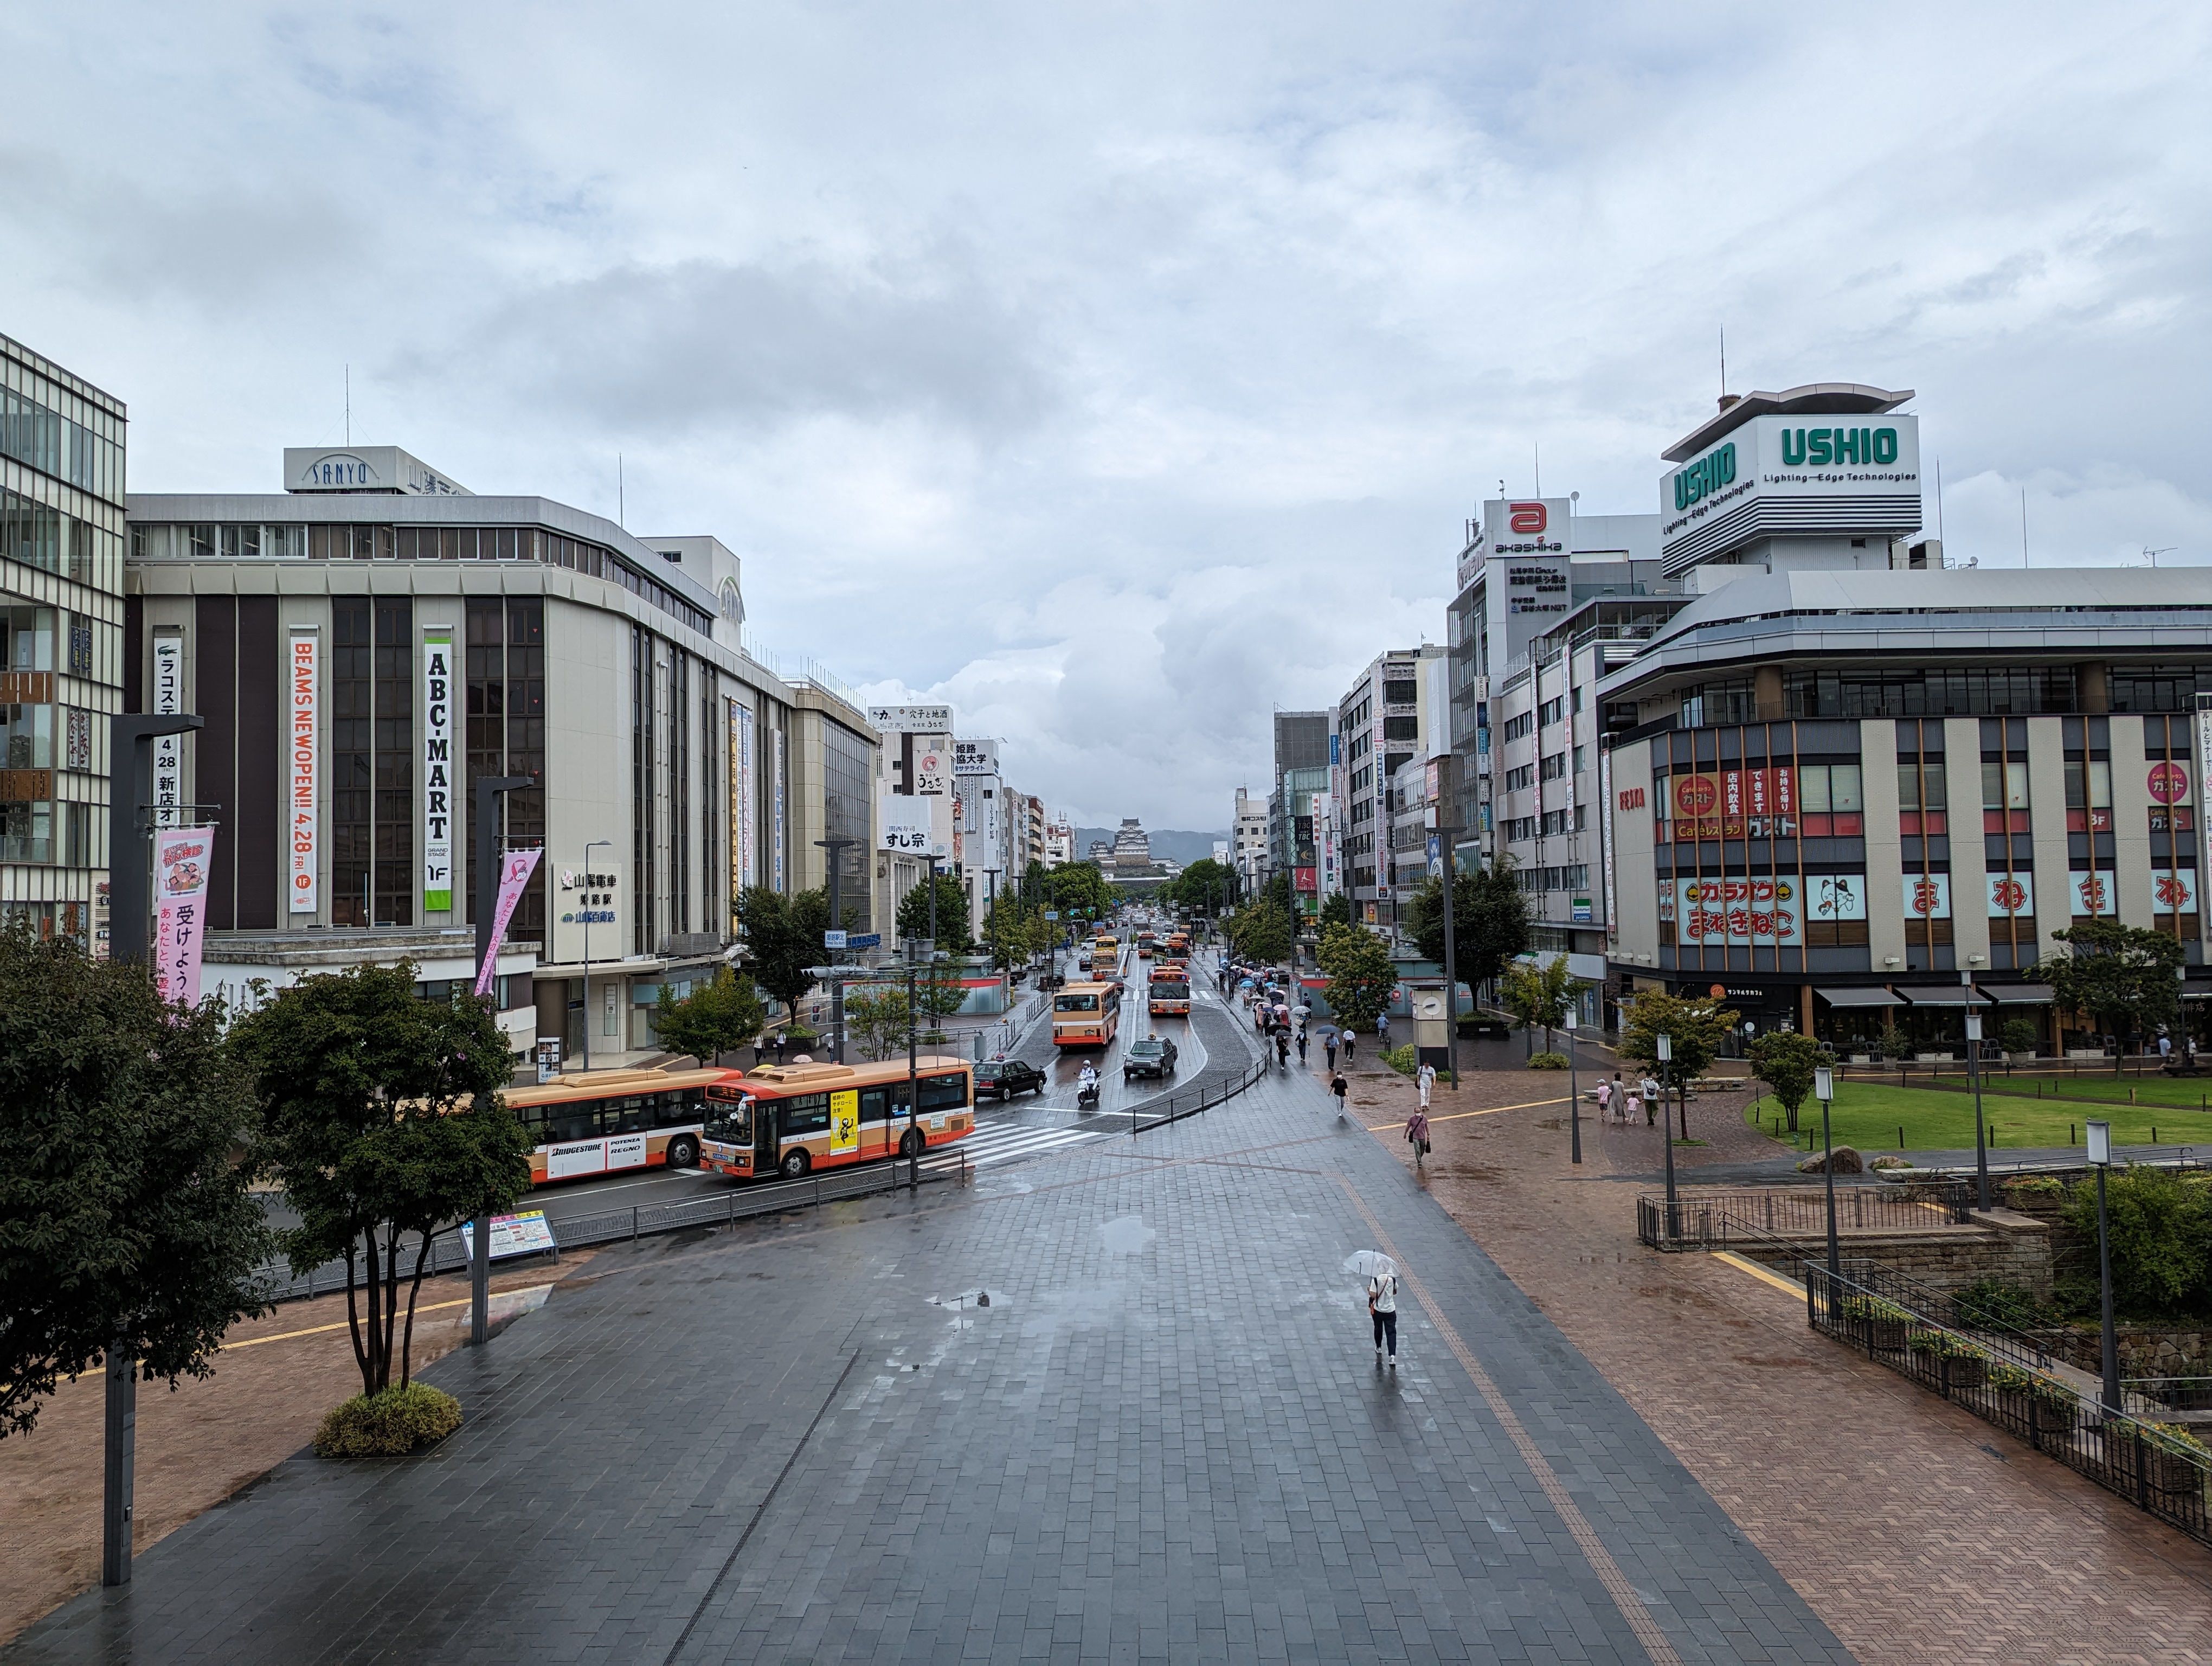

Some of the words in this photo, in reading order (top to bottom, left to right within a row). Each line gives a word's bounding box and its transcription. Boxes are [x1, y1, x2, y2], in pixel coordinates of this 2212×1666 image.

[1782, 428, 1898, 465] USHIO
[313, 463, 366, 484] SANYO
[1674, 442, 1735, 510] USHIO
[1847, 473, 1917, 482] Technologies
[1709, 479, 1753, 508] Technologies
[294, 643, 312, 705] BEAMS
[879, 710, 889, 720] 力
[909, 709, 947, 719] 穴子と地酒
[428, 653, 448, 840] ABC-MART
[956, 744, 976, 754] 姫路
[1565, 714, 1573, 787] 献血ルーム
[1619, 787, 1645, 811] FESTA
[1727, 772, 1739, 815] 店内飲食
[1752, 770, 1765, 813] できます
[1779, 768, 1789, 812] お持ち帰り
[294, 813, 312, 853] 4.28
[1748, 817, 1796, 837] ガスト
[886, 833, 925, 848] すし宗
[294, 856, 304, 869] FRI
[574, 874, 617, 888] 山陽電車
[1700, 881, 1774, 902] カラオケ
[580, 893, 612, 905] 姫路駅
[1913, 877, 1940, 915] ま
[1992, 879, 2028, 911] ね
[2078, 875, 2106, 911] き
[2156, 876, 2192, 907] ね
[575, 911, 616, 923] 山陽百貨店
[1687, 908, 1795, 939] まねきねこ
[176, 904, 194, 990] 受けよう
[551, 1143, 602, 1157] BRIDGESTONE
[610, 1145, 640, 1155] REGNO
